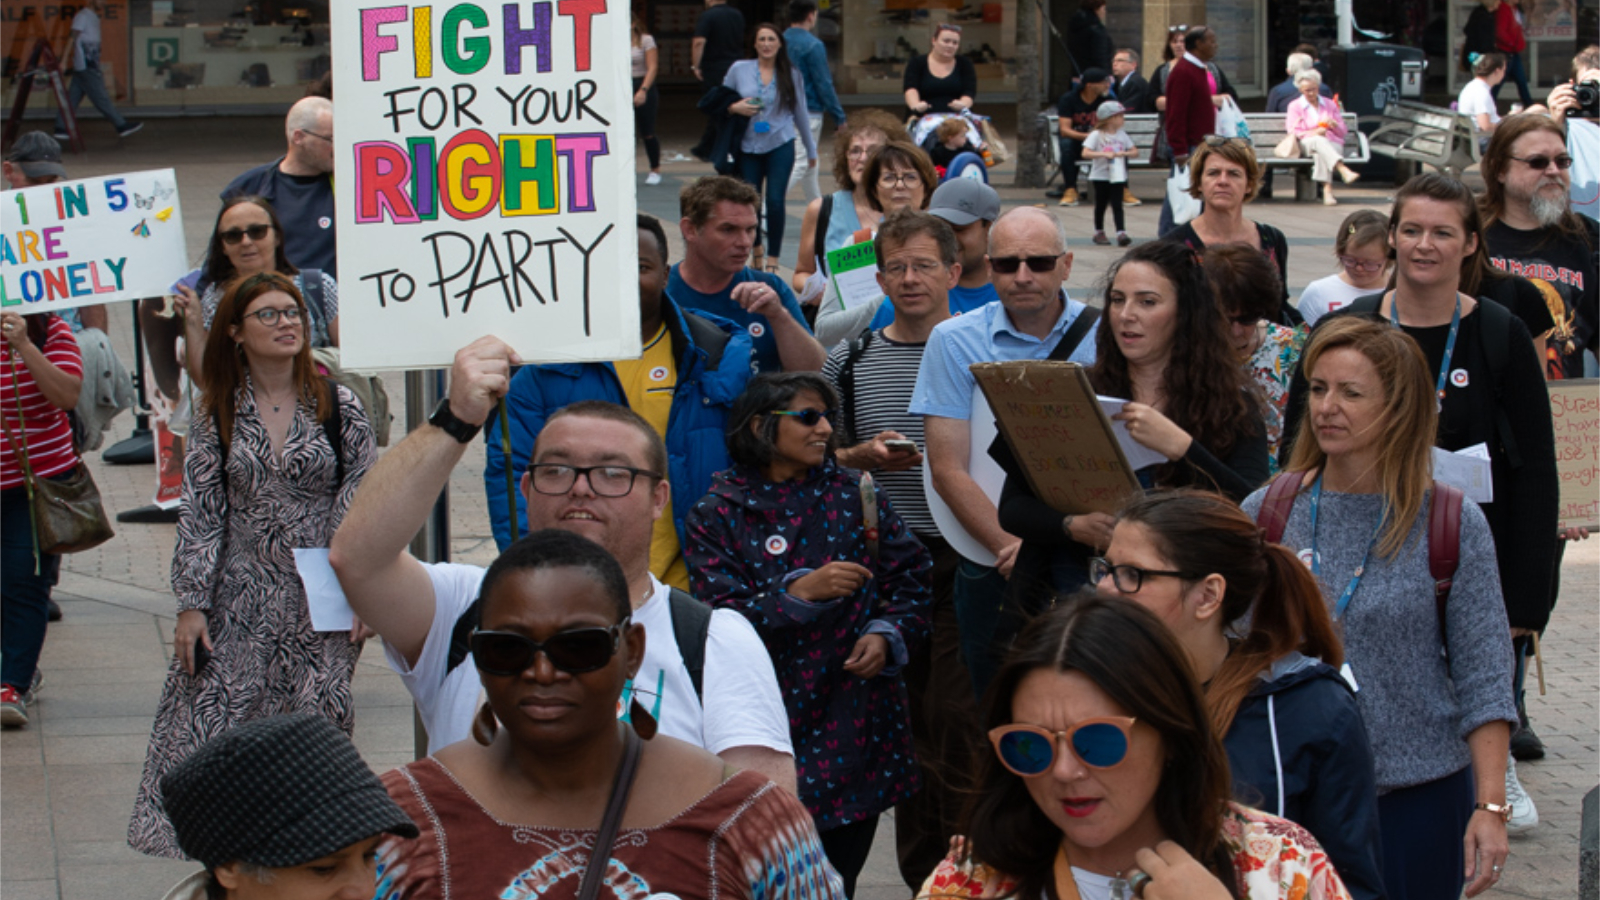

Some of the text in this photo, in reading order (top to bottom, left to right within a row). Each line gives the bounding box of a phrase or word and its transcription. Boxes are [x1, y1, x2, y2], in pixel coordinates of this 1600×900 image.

[359, 0, 608, 81] FIGHT
[383, 79, 610, 132] FOR YOUR
[15, 178, 129, 225] 1 IN 5
[353, 128, 609, 224] RIGHT
[0, 226, 69, 265] ARE
[0, 257, 127, 307] LONELY
[360, 223, 614, 336] TO PARTY
[1508, 258, 1584, 291] MAIDEN
